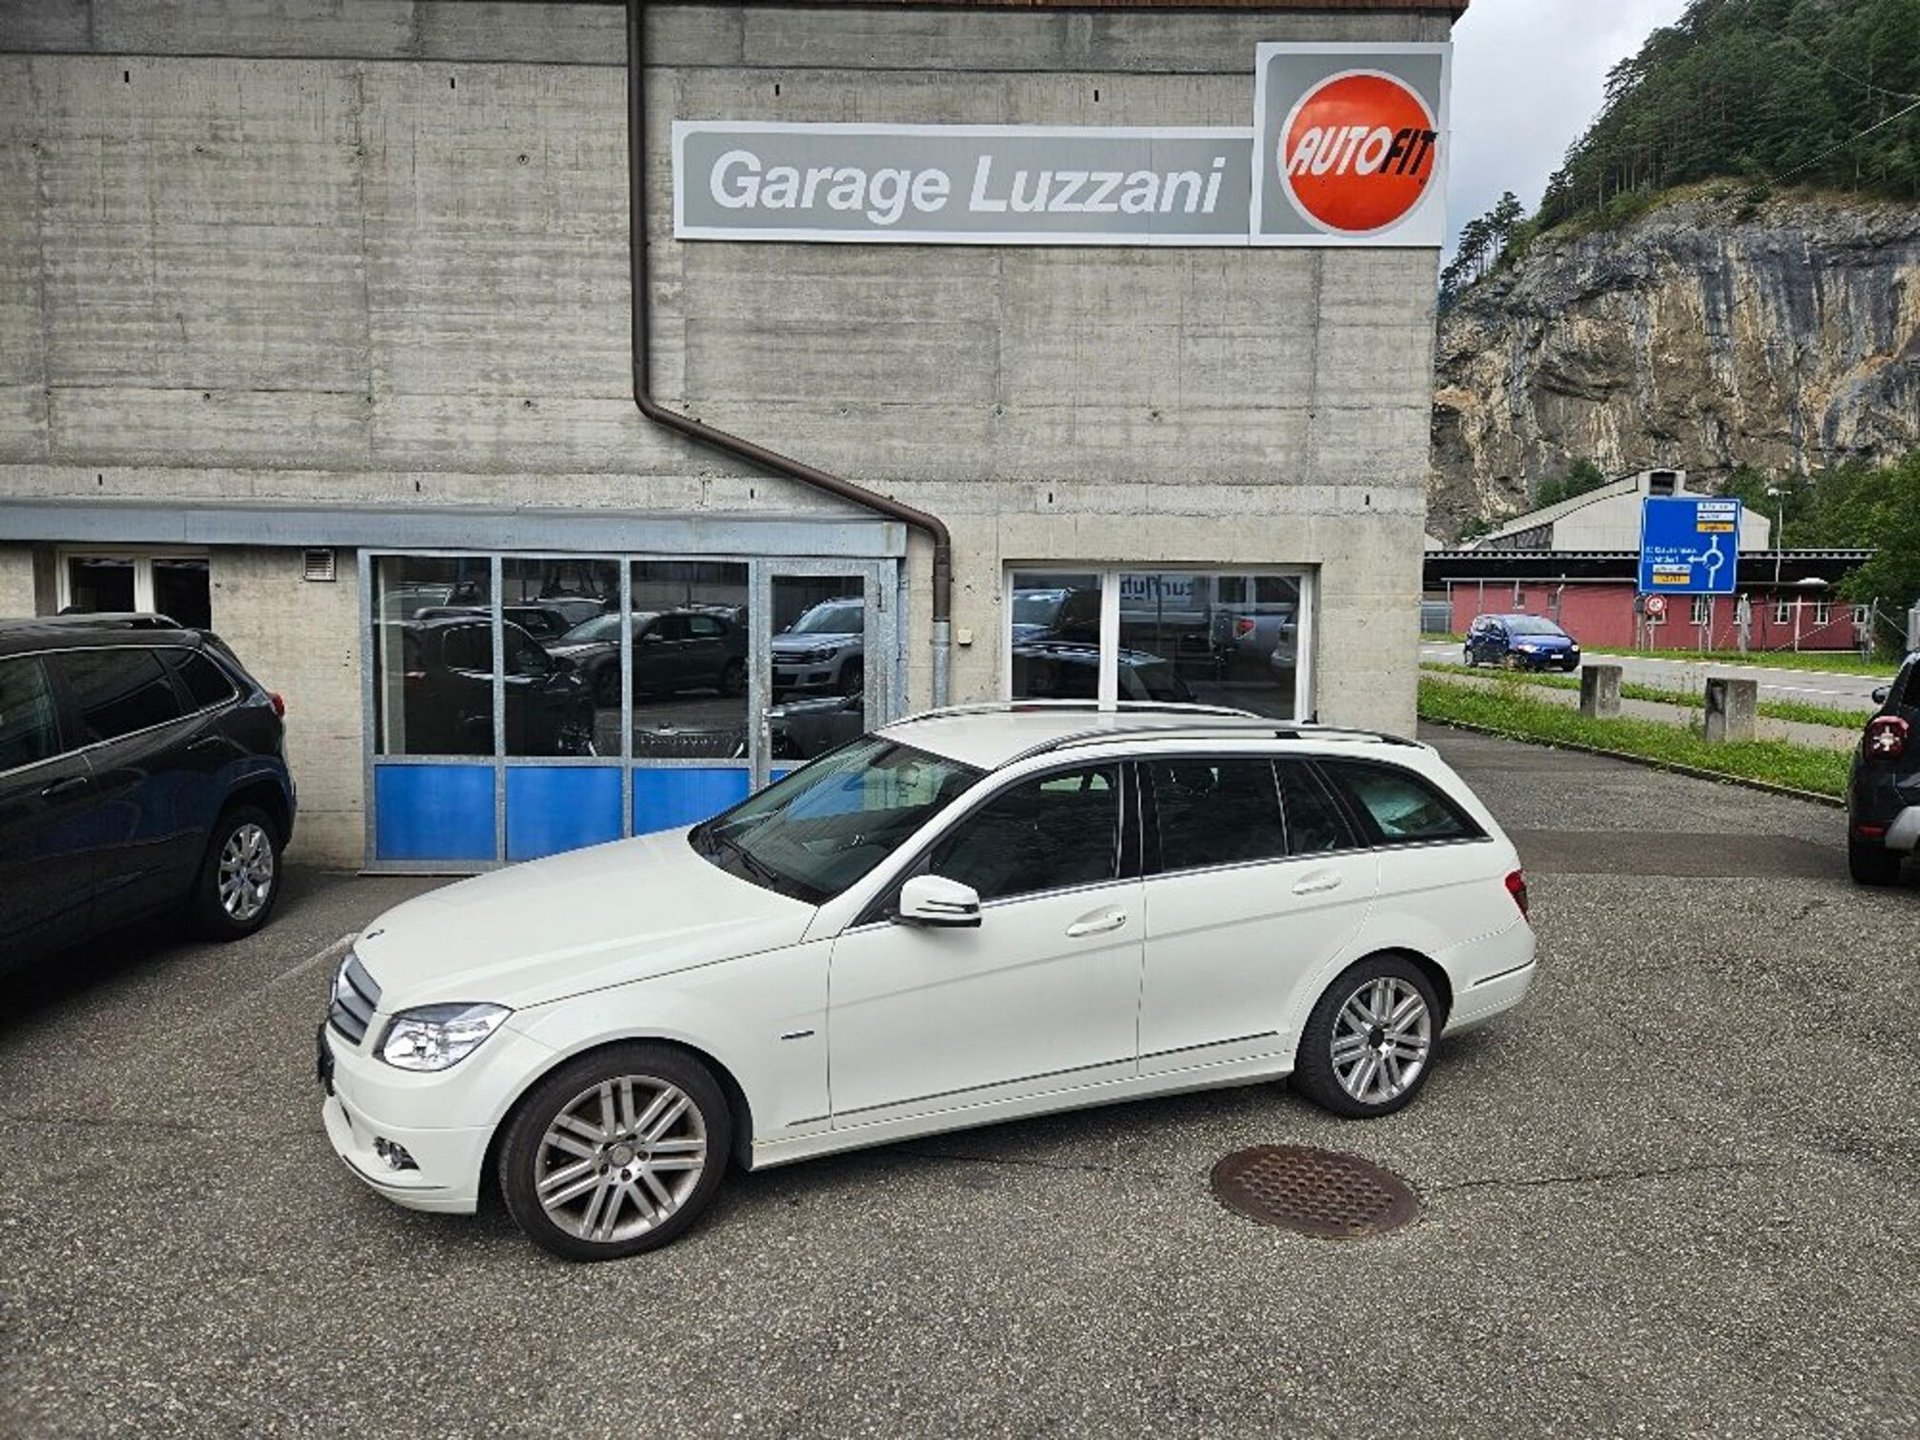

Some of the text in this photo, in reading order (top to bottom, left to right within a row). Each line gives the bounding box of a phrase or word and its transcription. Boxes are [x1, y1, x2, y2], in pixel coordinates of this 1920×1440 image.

[1288, 126, 1438, 176] AUTOFIT
[710, 150, 1226, 225] Garage Luzzani
